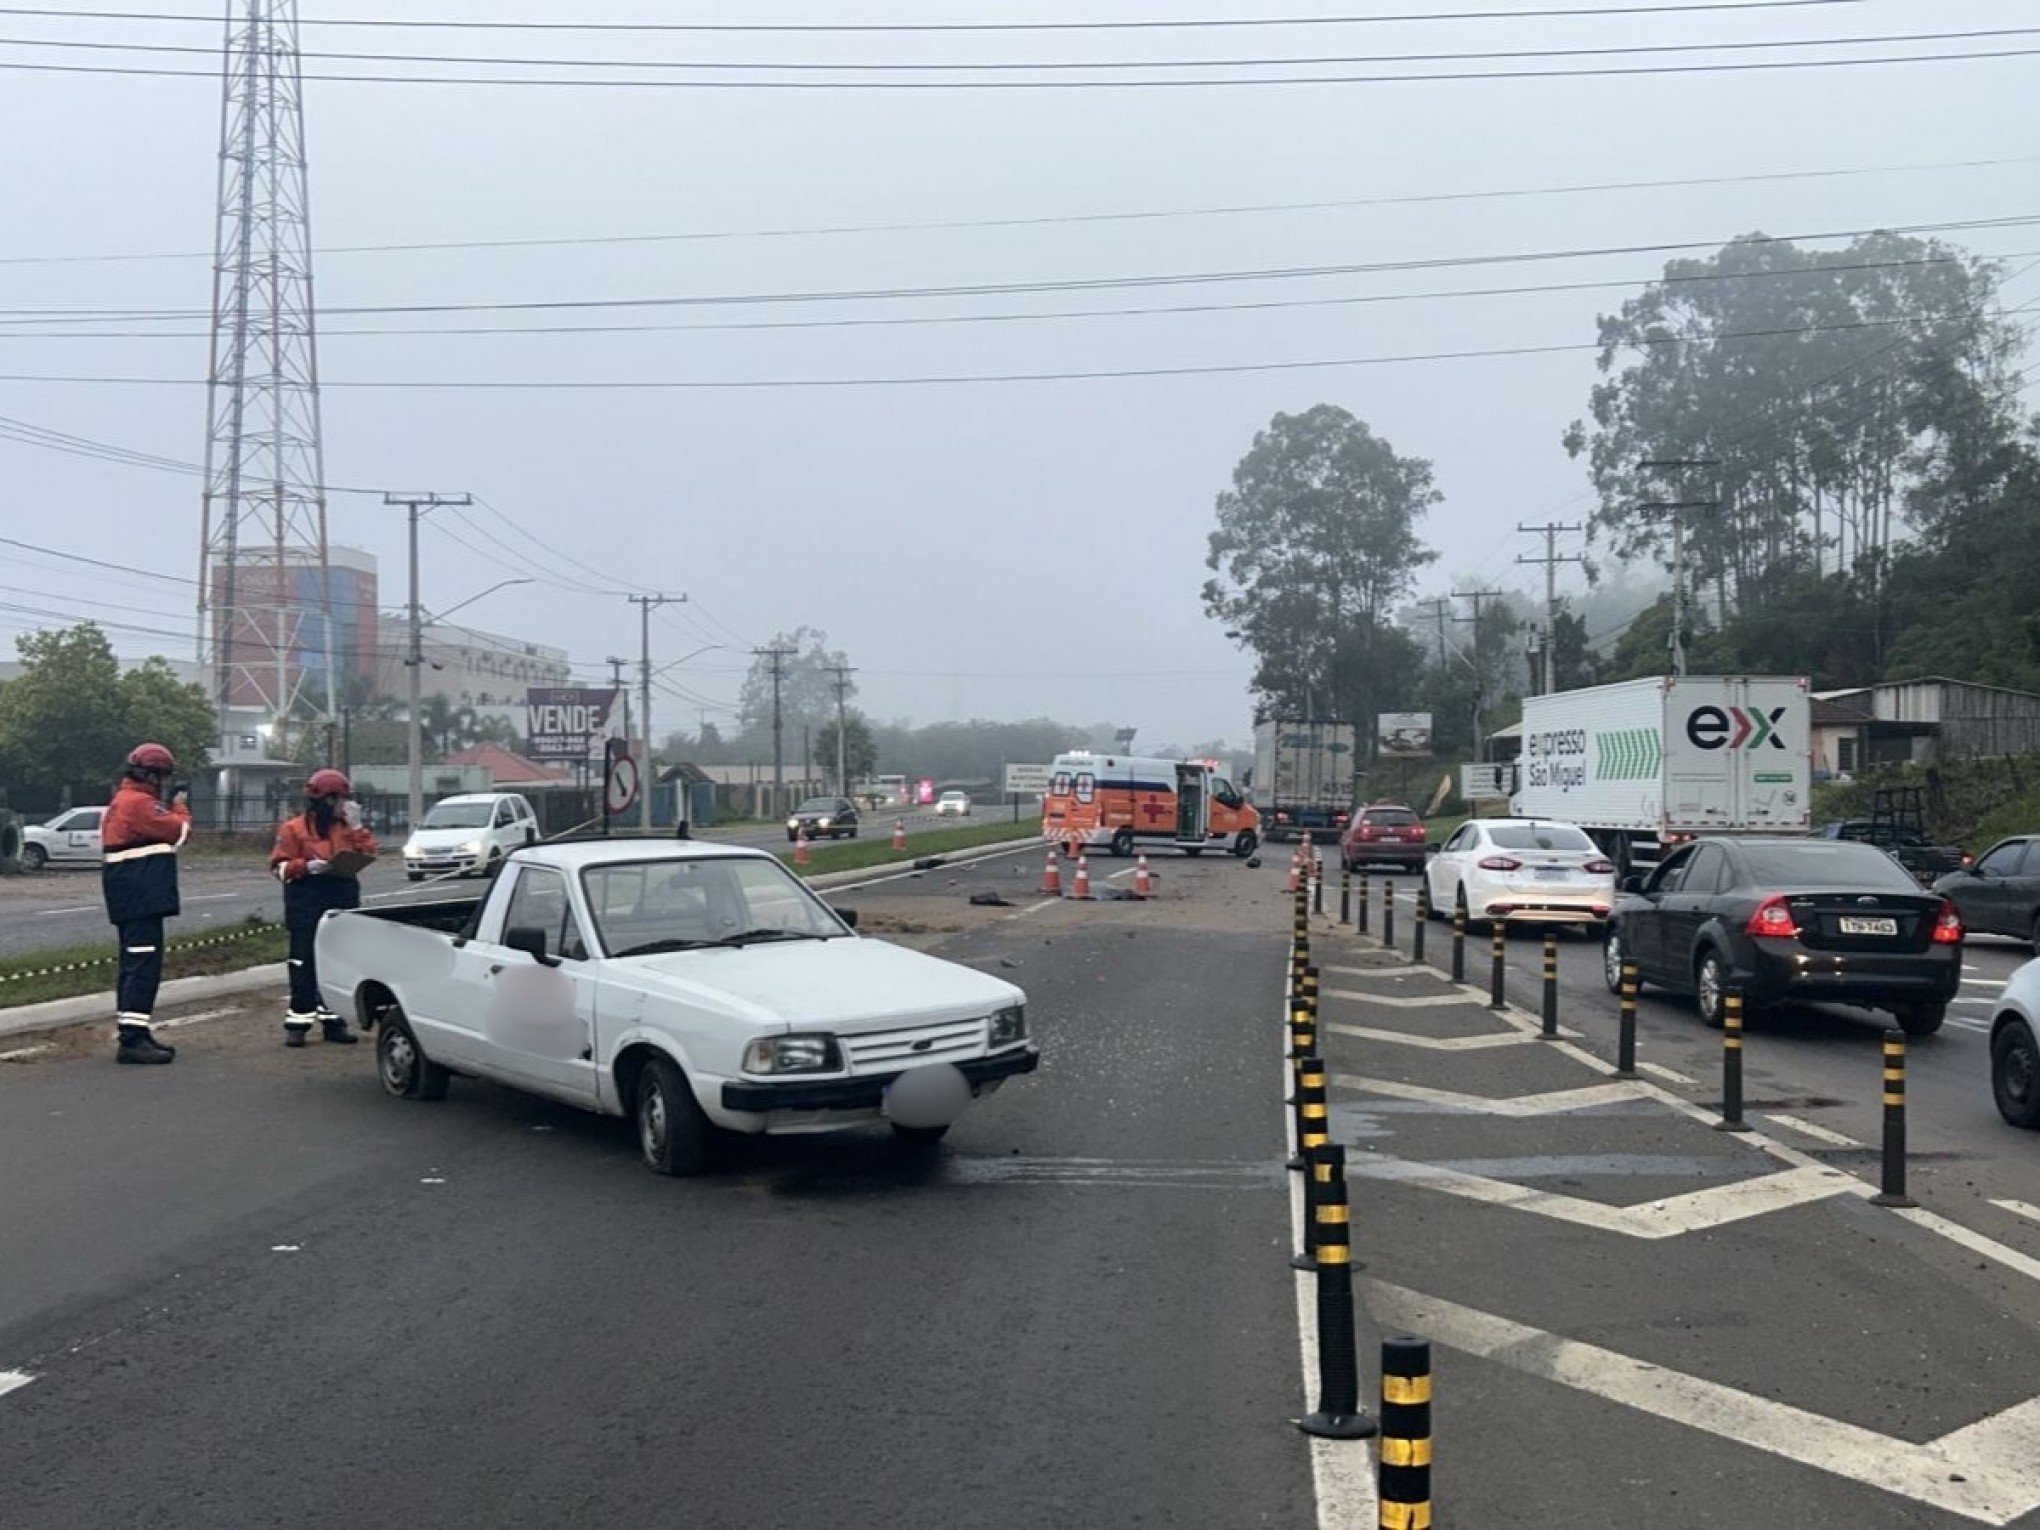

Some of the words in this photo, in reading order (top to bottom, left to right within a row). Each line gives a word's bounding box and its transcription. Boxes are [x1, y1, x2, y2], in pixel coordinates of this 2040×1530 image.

[528, 704, 600, 733] VENDE
[1530, 729, 1586, 763] expresso
[1530, 760, 1547, 786] São
[1550, 759, 1586, 792] Miguel
